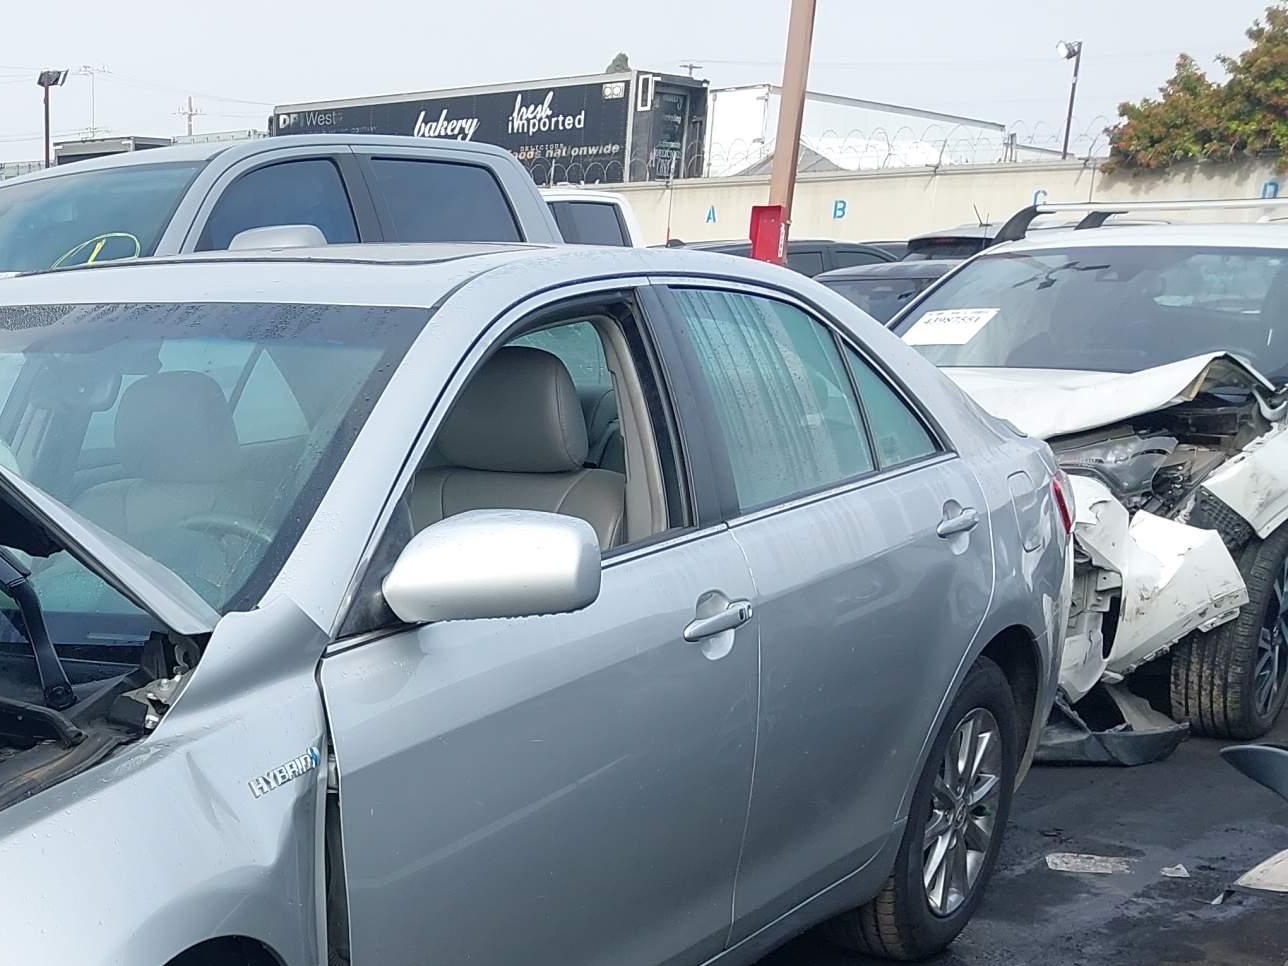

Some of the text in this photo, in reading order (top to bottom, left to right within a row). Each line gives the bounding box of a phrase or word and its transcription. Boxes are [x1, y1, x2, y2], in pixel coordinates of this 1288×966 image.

[305, 111, 337, 127] West
[511, 91, 554, 122] fresh
[414, 108, 481, 142] bakery
[508, 110, 585, 136] imported
[706, 206, 716, 223] A
[833, 200, 847, 219] B
[248, 752, 314, 799] HYBRID
